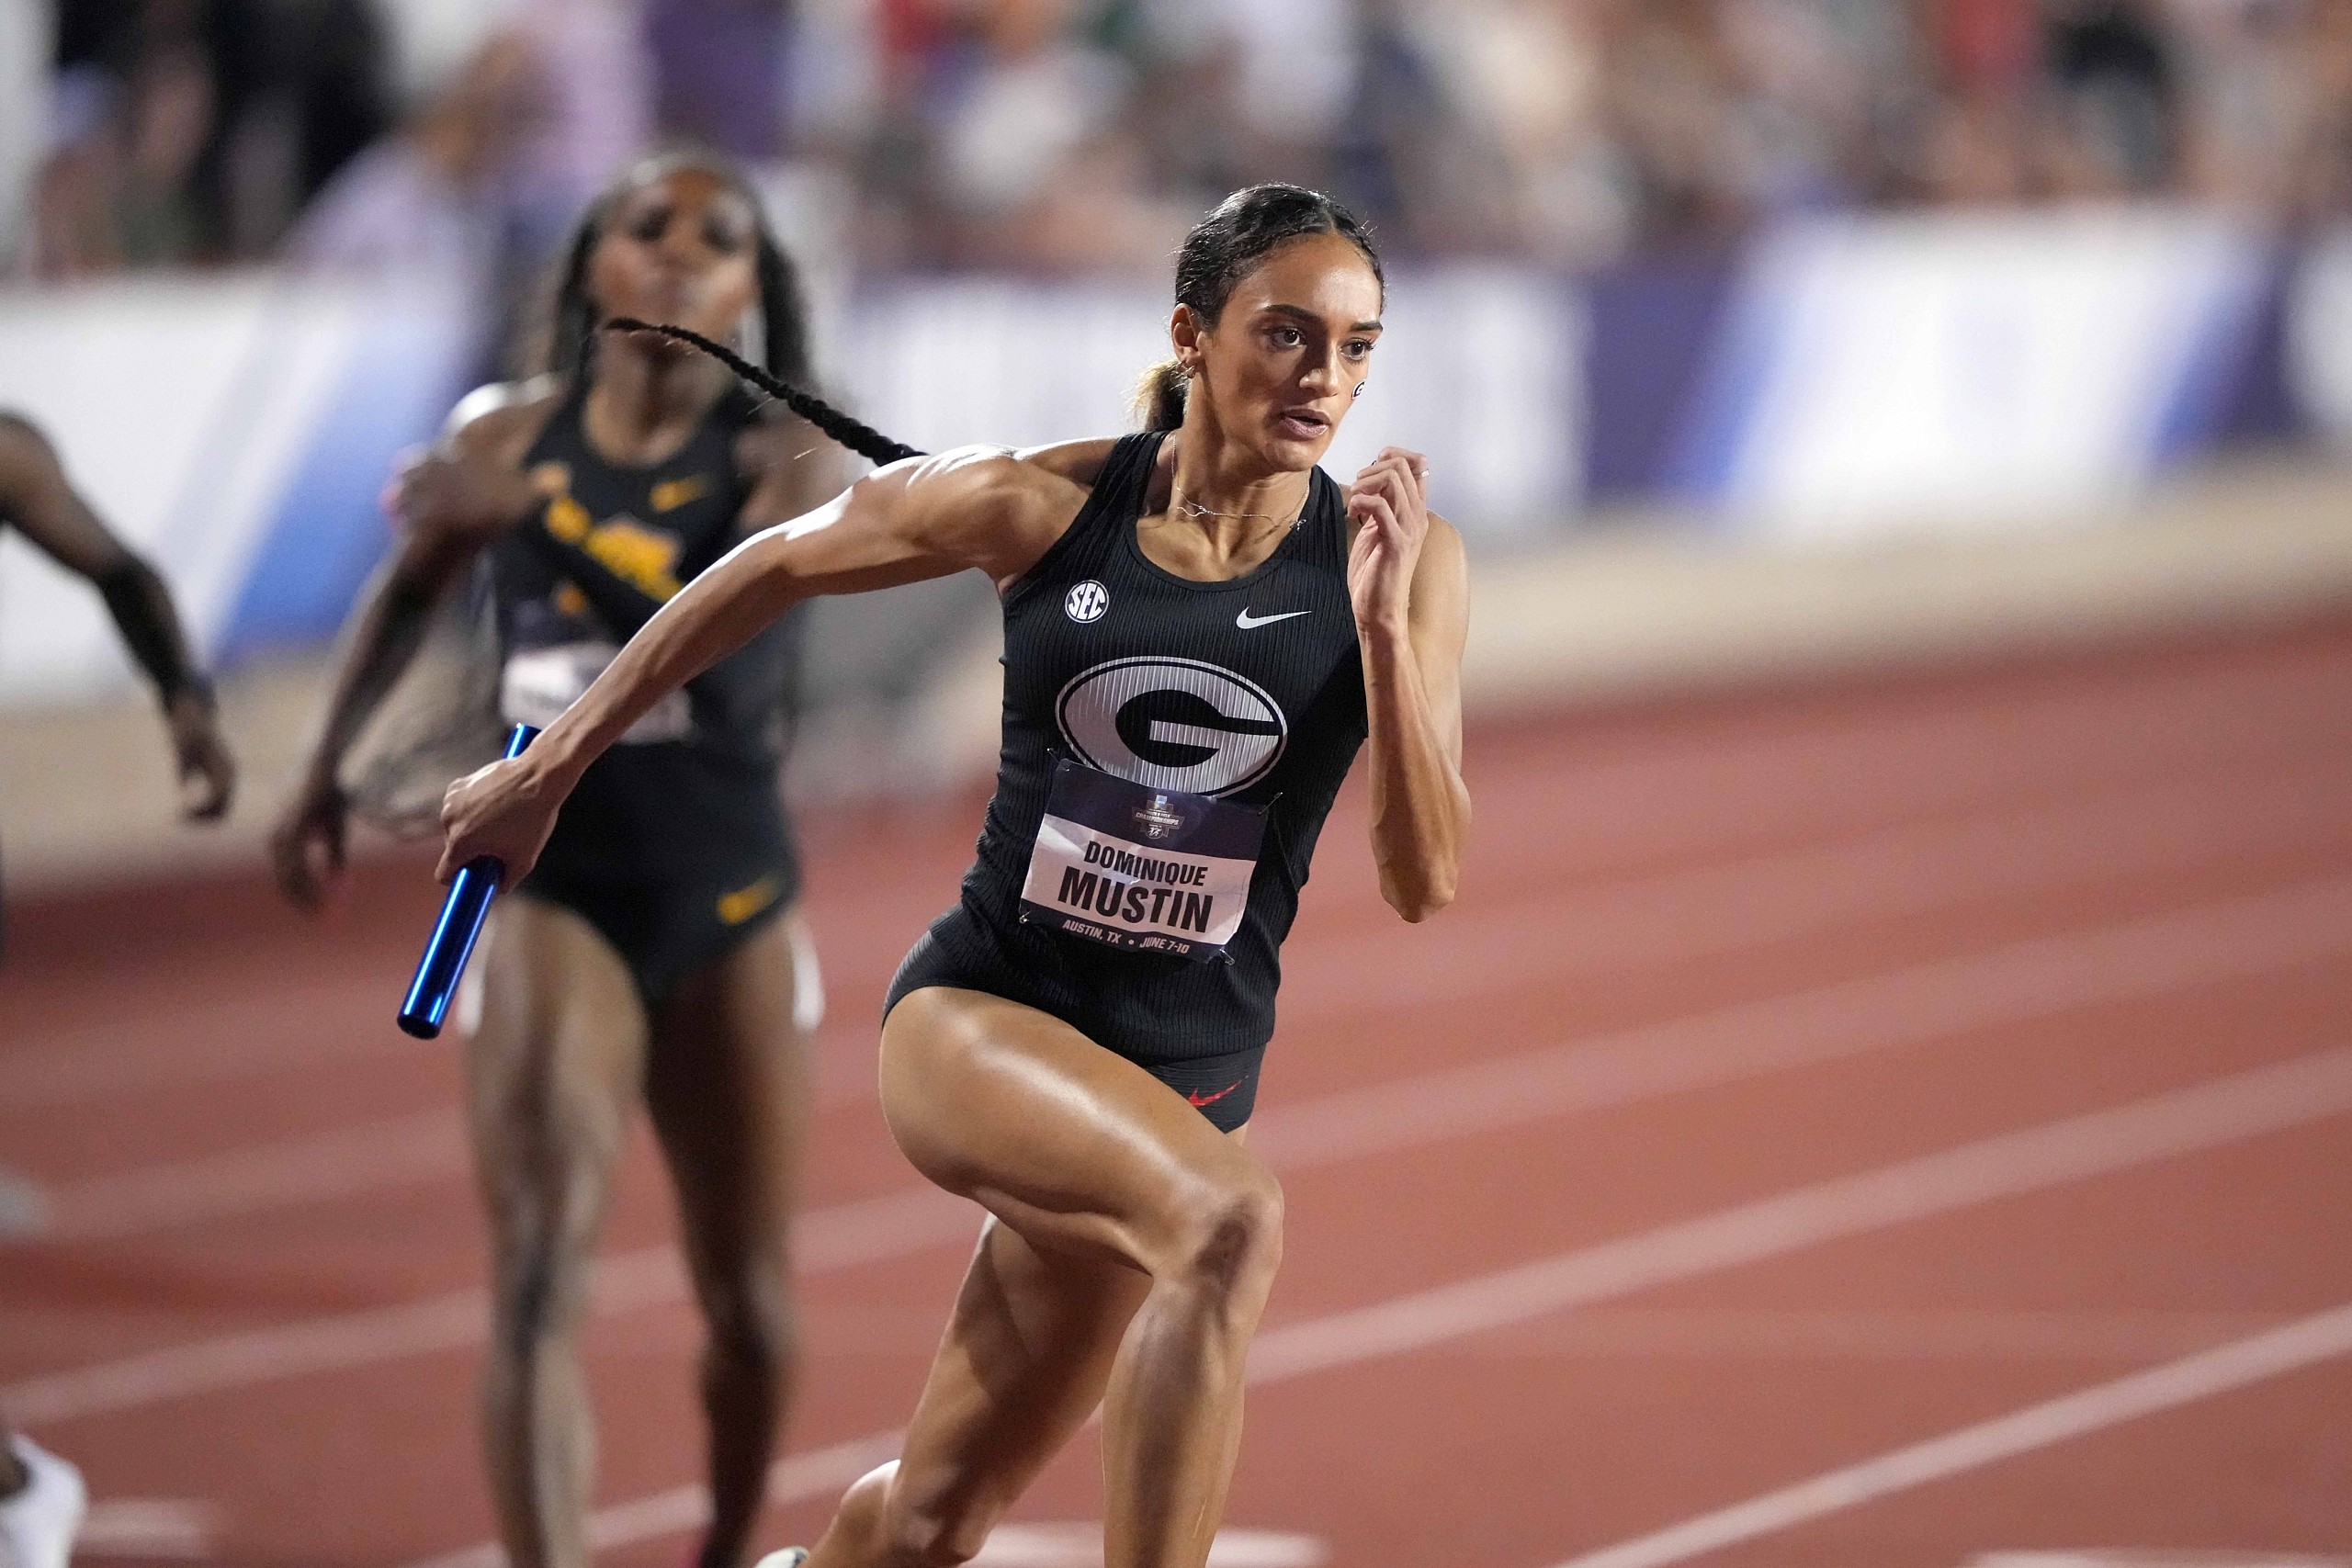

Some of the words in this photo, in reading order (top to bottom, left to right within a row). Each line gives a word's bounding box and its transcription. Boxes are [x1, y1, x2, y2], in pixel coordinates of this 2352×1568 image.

[1068, 582, 1106, 620] SEC
[1055, 655, 1288, 799] G
[1083, 840, 1208, 886] DOMINIQUE
[1057, 865, 1214, 933] MUSTIN
[1062, 919, 1102, 940] AUSTIN,
[1107, 931, 1122, 944] TX
[1139, 936, 1167, 949] JUNE
[1167, 940, 1191, 954] 7-10
